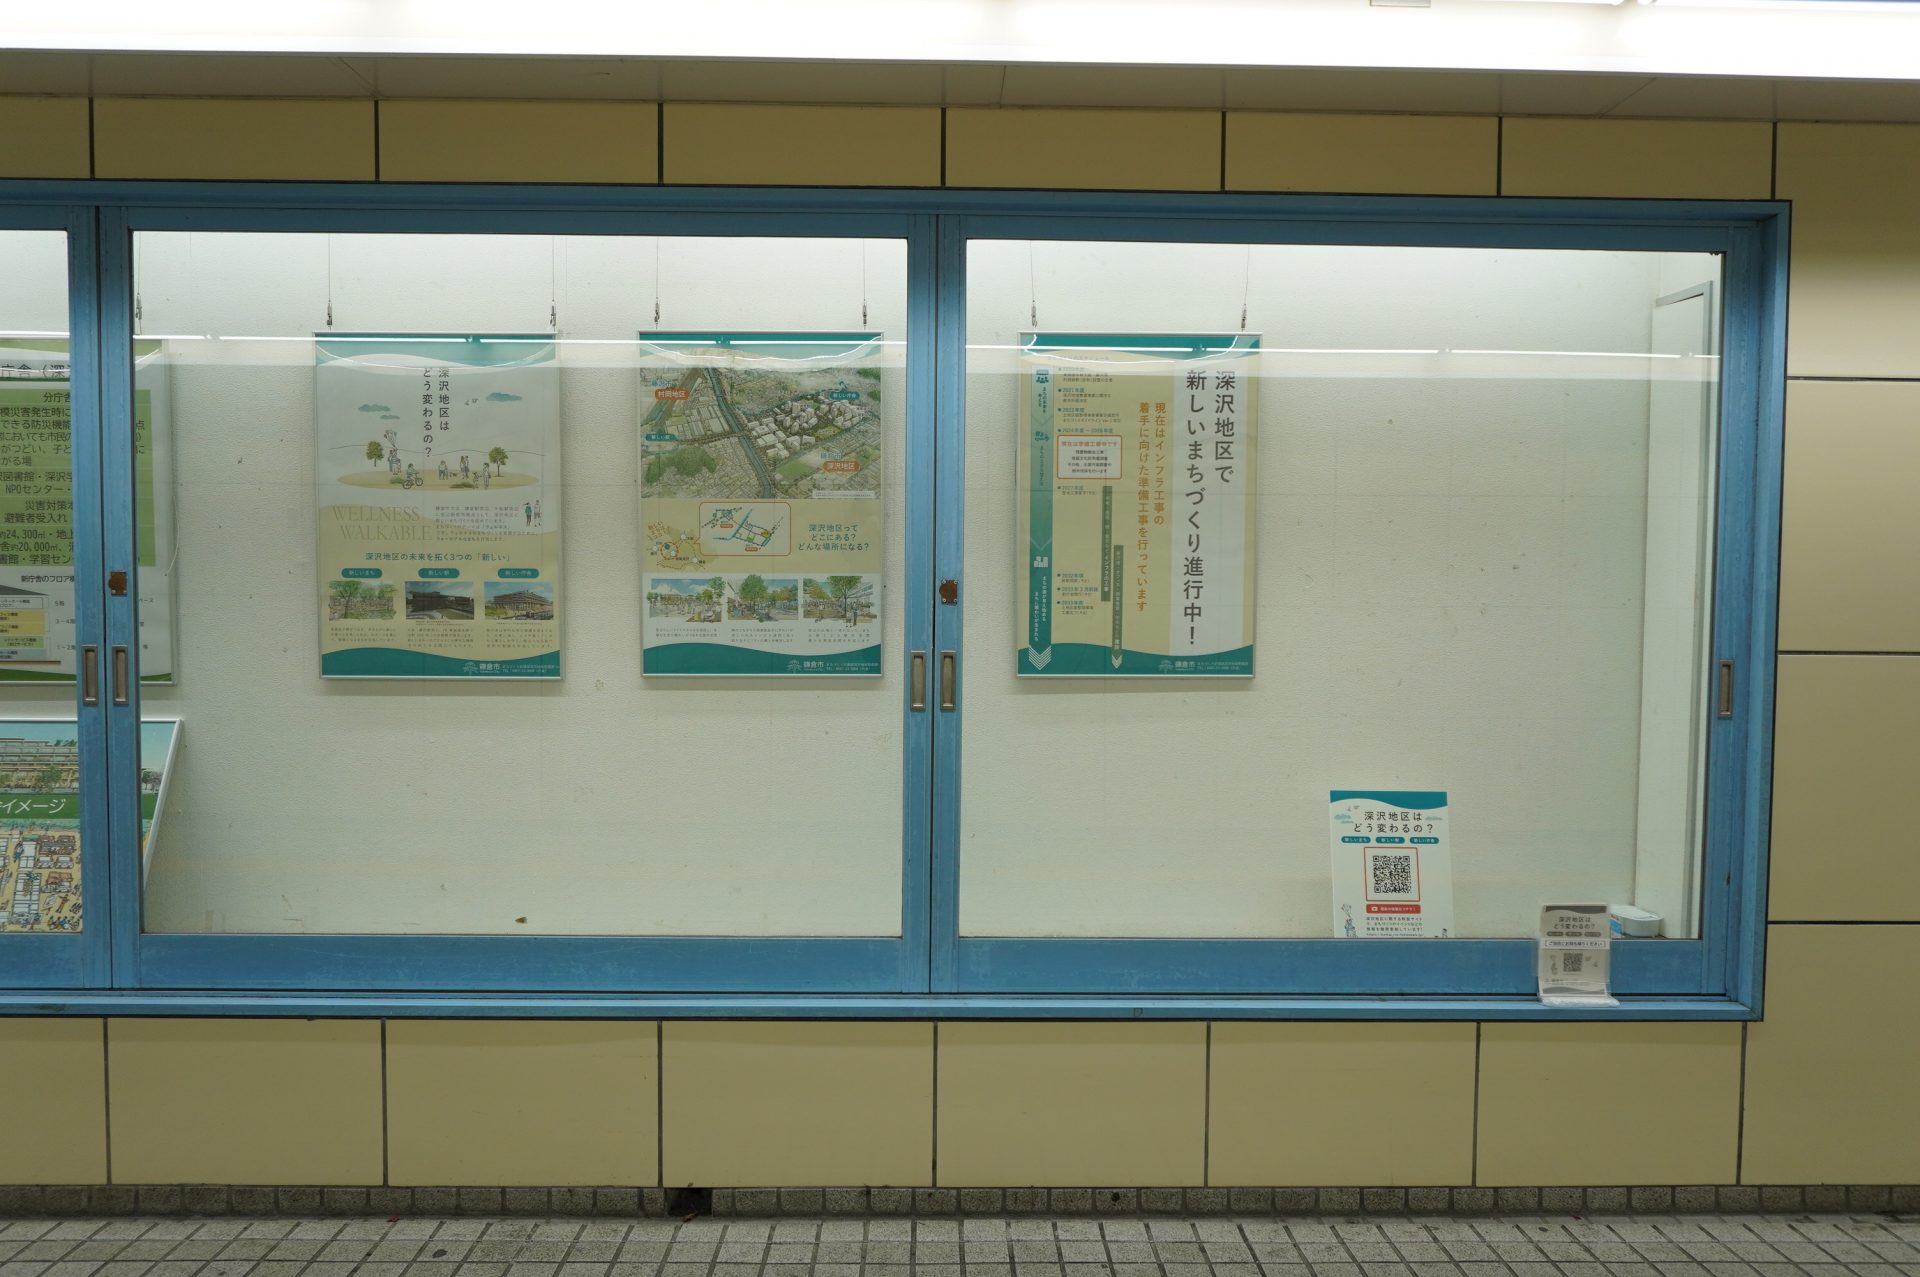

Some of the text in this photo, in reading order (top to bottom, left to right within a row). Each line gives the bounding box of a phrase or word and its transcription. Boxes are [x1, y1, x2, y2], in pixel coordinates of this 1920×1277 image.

[1213, 369, 1236, 483] 深沢地区で
[1153, 402, 1167, 525] 現在はインフラ工事の
[331, 506, 421, 522] WELLNESS
[1137, 402, 1151, 612] 着手に向けた準備工事を行っています
[340, 525, 433, 541] WALKABLE
[808, 524, 858, 532] 深沢地区って
[0, 798, 67, 815] イメージ
[1364, 811, 1423, 822] 深沢地区は
[1353, 823, 1433, 834] どう変わるの？
